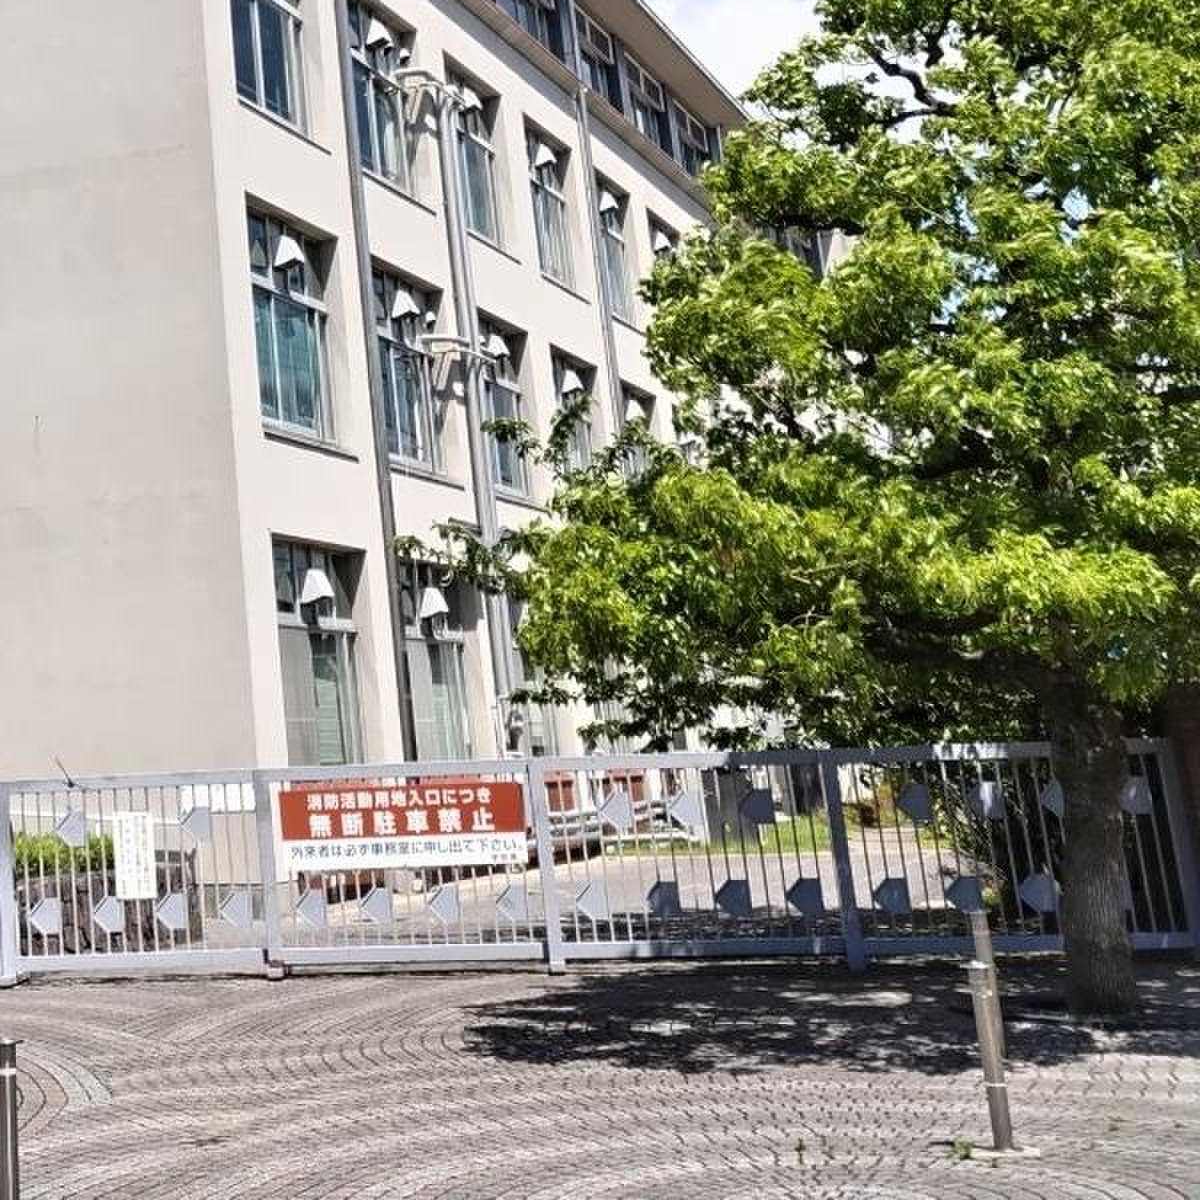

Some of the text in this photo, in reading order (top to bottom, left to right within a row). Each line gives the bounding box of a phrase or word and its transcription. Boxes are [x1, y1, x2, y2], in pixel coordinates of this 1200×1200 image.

[308, 808, 496, 837] 無断駐車禁止
